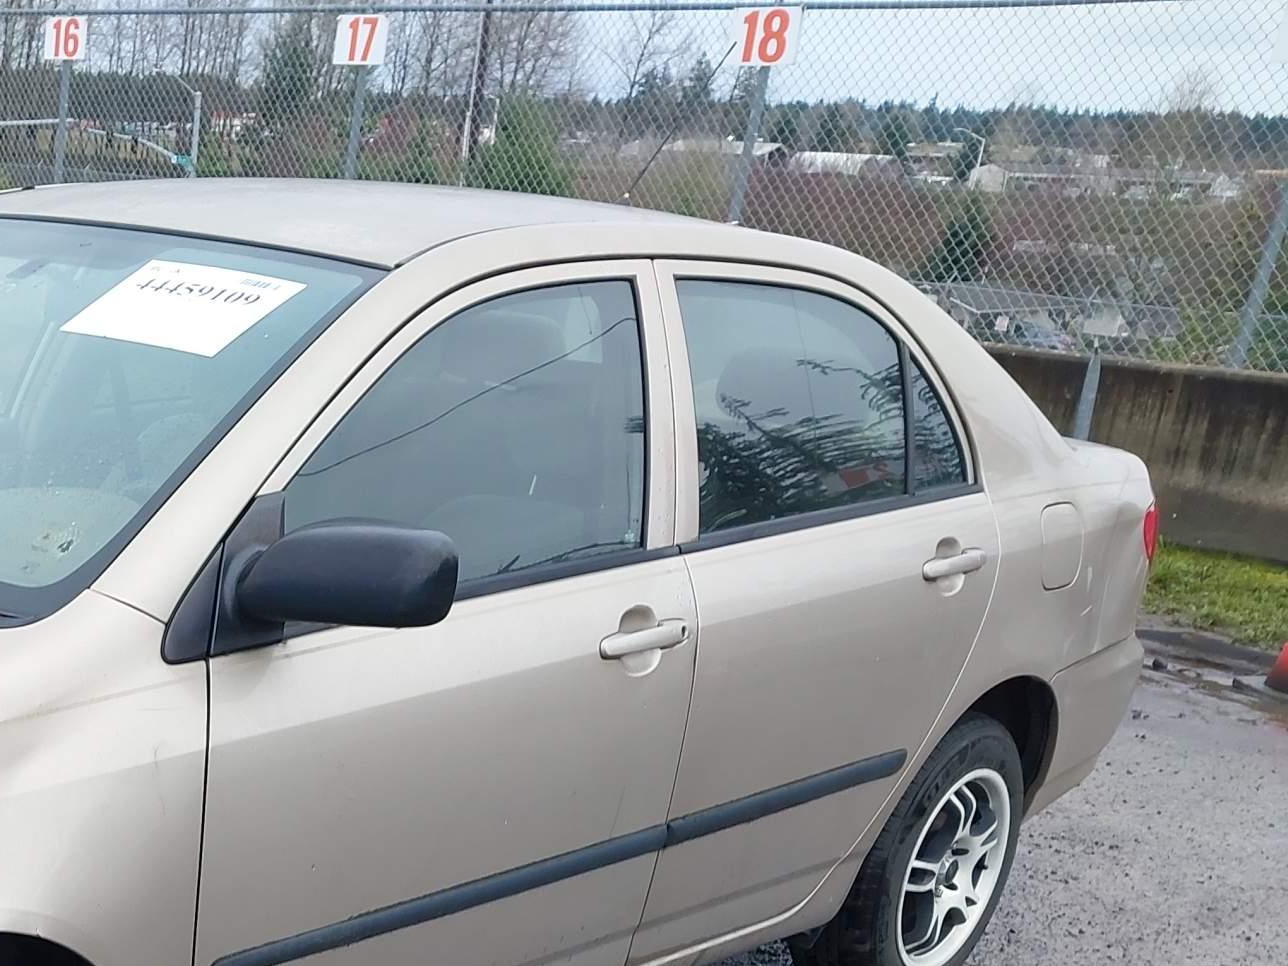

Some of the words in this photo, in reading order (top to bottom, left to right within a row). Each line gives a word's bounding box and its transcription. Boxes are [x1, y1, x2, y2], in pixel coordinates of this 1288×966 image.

[52, 17, 80, 58] 16
[347, 16, 380, 62] 17
[741, 8, 790, 63] 18
